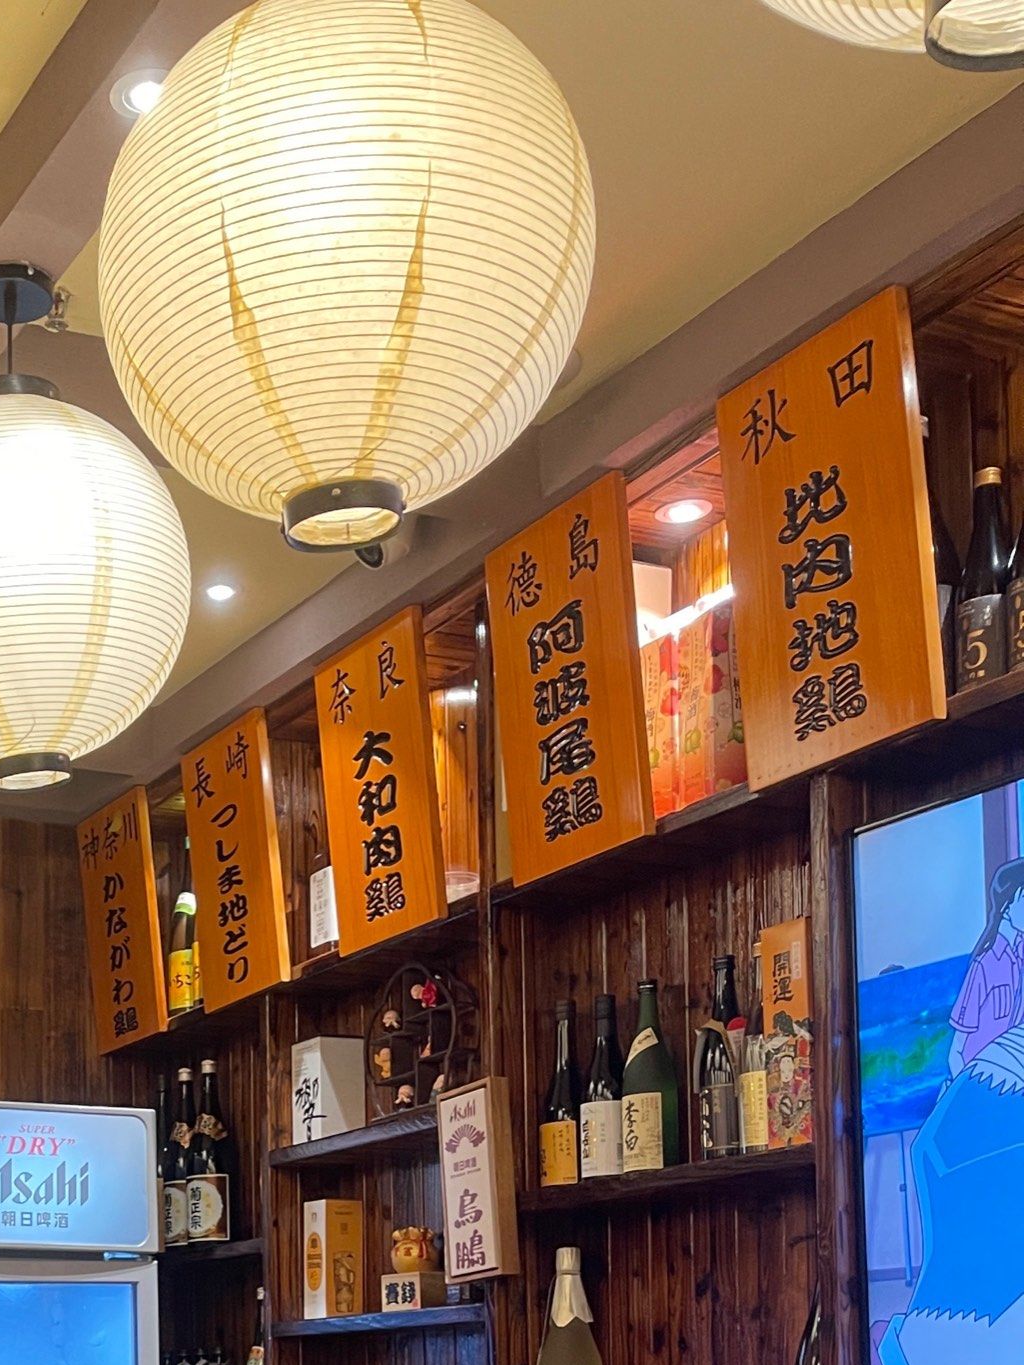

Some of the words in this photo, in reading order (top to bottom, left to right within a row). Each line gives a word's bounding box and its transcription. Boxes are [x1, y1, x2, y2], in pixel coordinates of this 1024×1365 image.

[740, 338, 874, 466] 秋田
[329, 641, 404, 724] 奈良
[191, 731, 249, 809] 長崎
[81, 803, 139, 870] 神奈川
[209, 803, 250, 985] つしま地どり
[772, 951, 794, 1005] 開運
[19, 1124, 56, 1134] SUPER
[625, 1101, 639, 1151] 李白
[1, 1210, 69, 1229] 朝日啤酒
